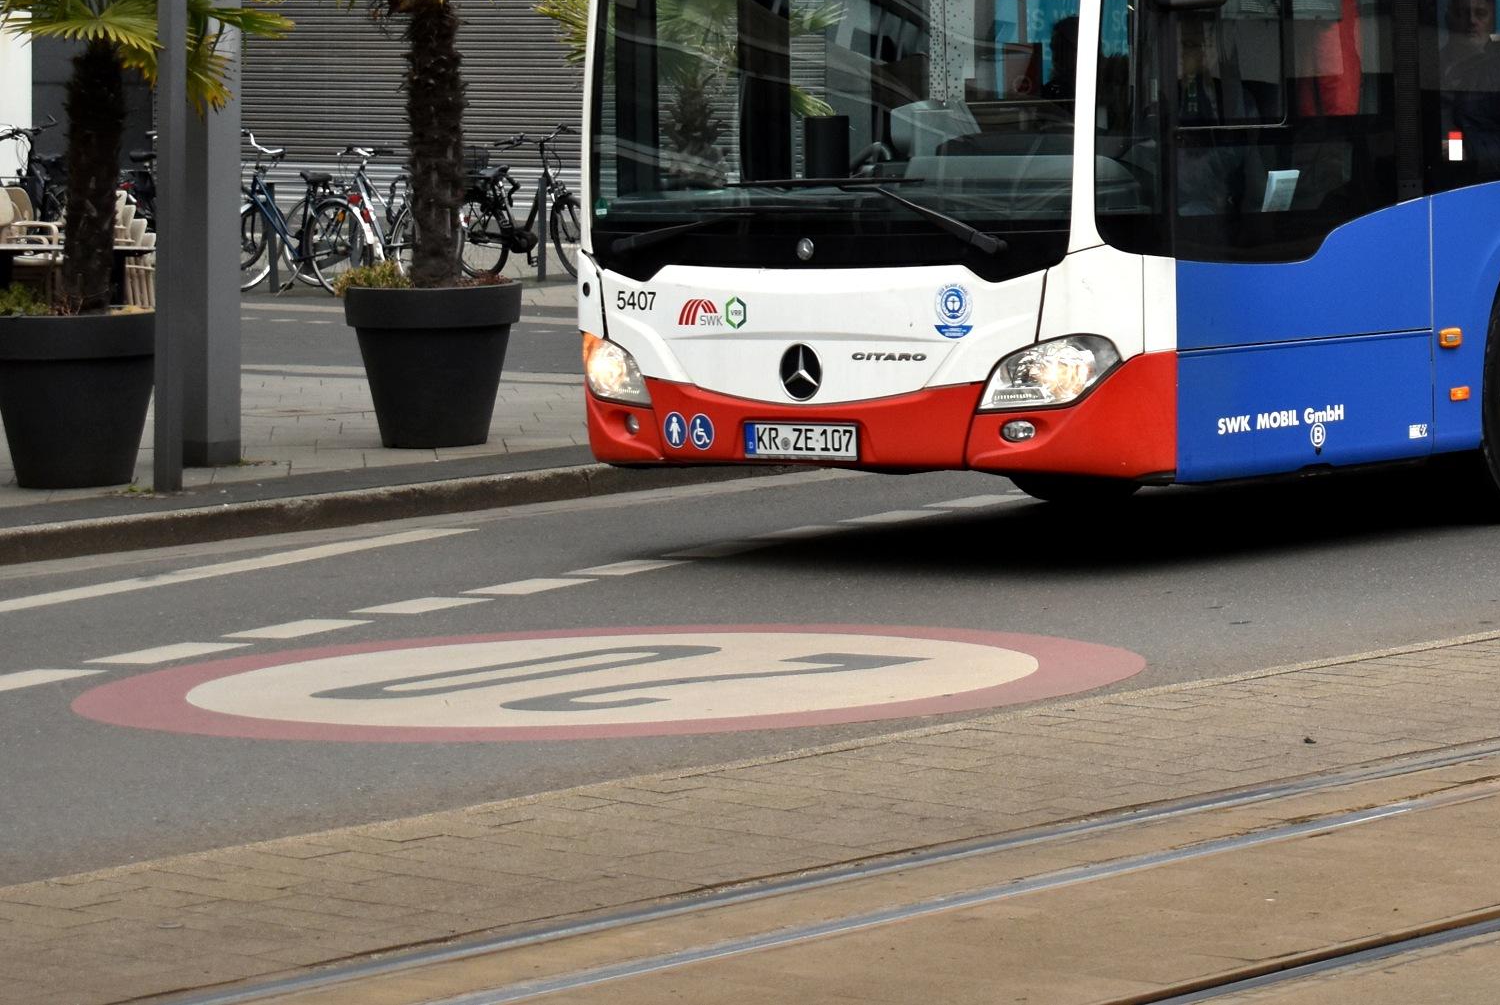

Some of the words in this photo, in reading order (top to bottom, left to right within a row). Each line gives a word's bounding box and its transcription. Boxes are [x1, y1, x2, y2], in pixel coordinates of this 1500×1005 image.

[616, 290, 657, 311] 5407
[700, 315, 723, 326] SWK
[851, 351, 927, 362] CITARO
[1217, 415, 1251, 435] SWK
[1256, 409, 1299, 430] MOBIL
[1303, 404, 1344, 424] GmbH
[756, 427, 780, 450] KR
